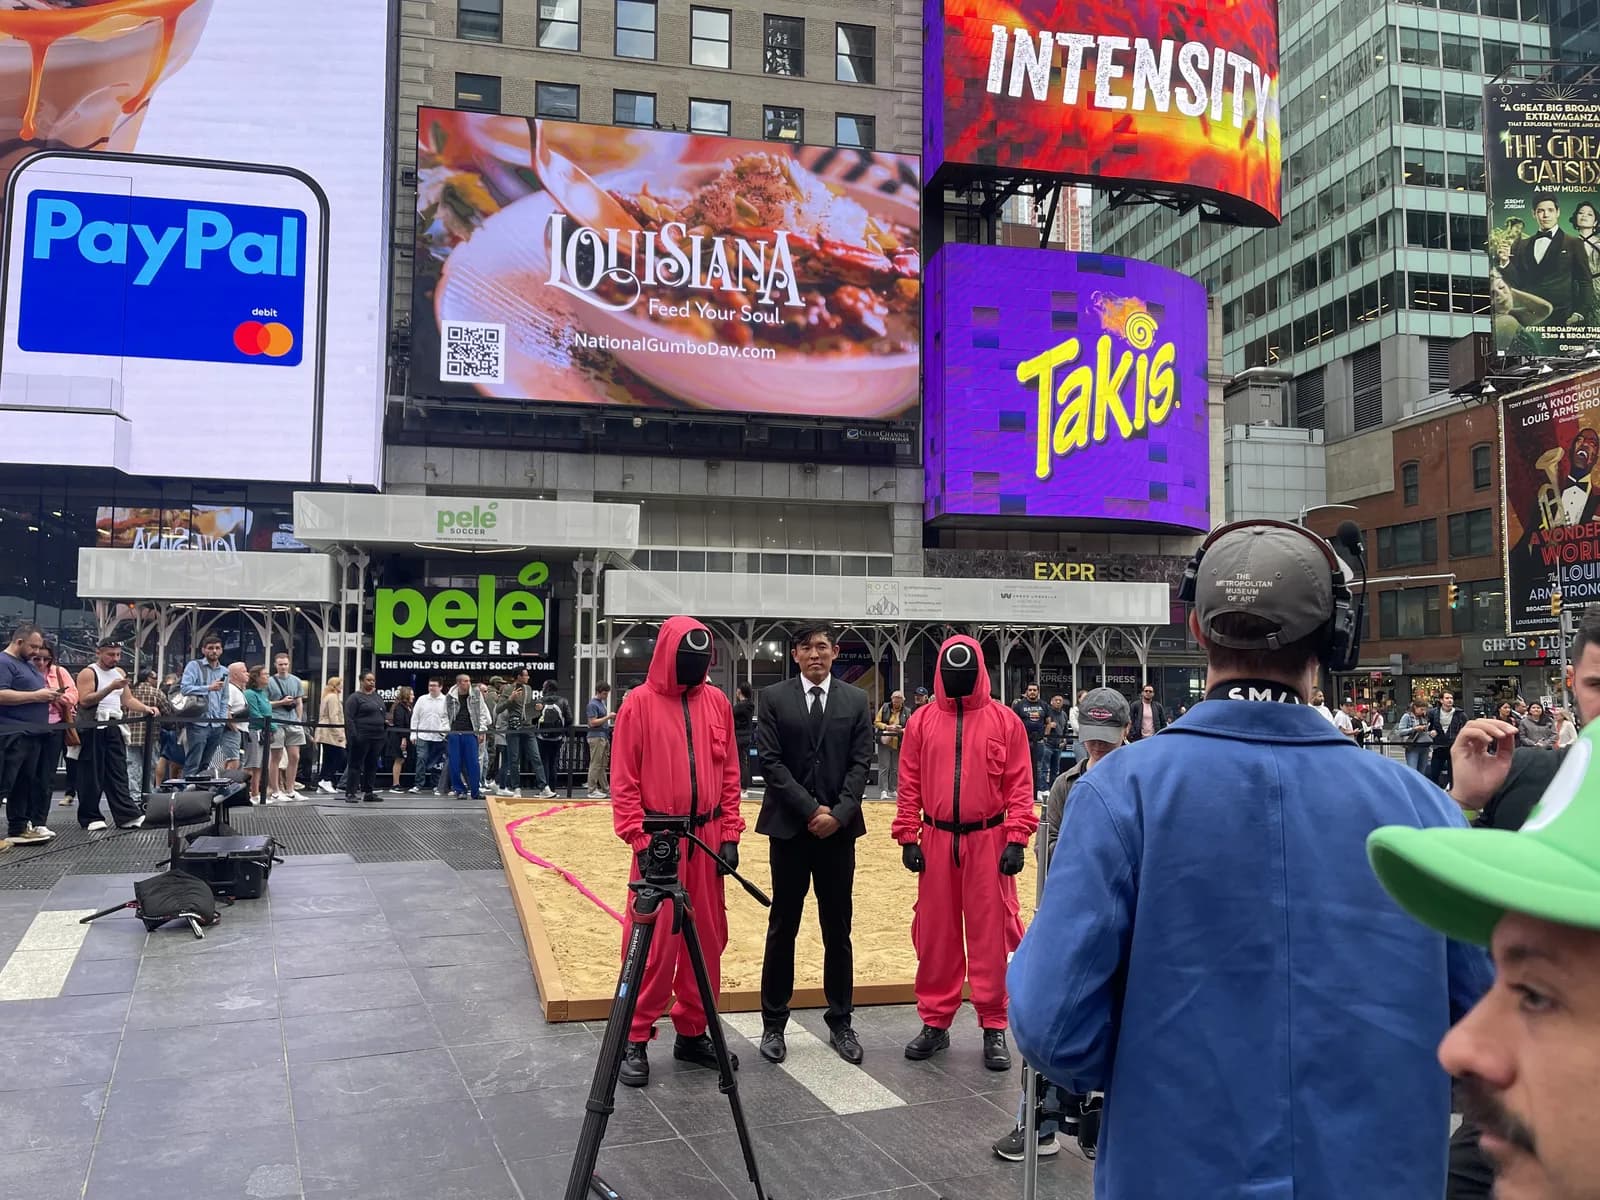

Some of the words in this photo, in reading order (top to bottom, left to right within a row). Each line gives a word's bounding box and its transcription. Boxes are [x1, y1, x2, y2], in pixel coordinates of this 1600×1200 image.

[986, 24, 1270, 142] INTENSITY
[1546, 104, 1563, 112] BIG
[1565, 105, 1600, 113] BROAD
[1504, 133, 1542, 158] THE
[33, 198, 298, 286] PayPal
[544, 212, 806, 312] LOUISIANA
[252, 307, 278, 317] debit
[648, 298, 690, 320] Feed
[695, 301, 736, 323] Your
[740, 307, 786, 326] Soul.
[574, 332, 777, 361] NationalGumboDay.com
[1522, 411, 1550, 426] LOUIS
[437, 502, 498, 533] pelé
[1529, 532, 1540, 544] A
[1034, 562, 1136, 581] EXPRESS
[374, 561, 549, 655] pelé
[412, 640, 519, 655] SOCCER
[1482, 637, 1526, 651] GIFTS
[380, 660, 398, 669] THE
[400, 660, 439, 670] WORLD'S
[441, 662, 488, 670] GREATEST
